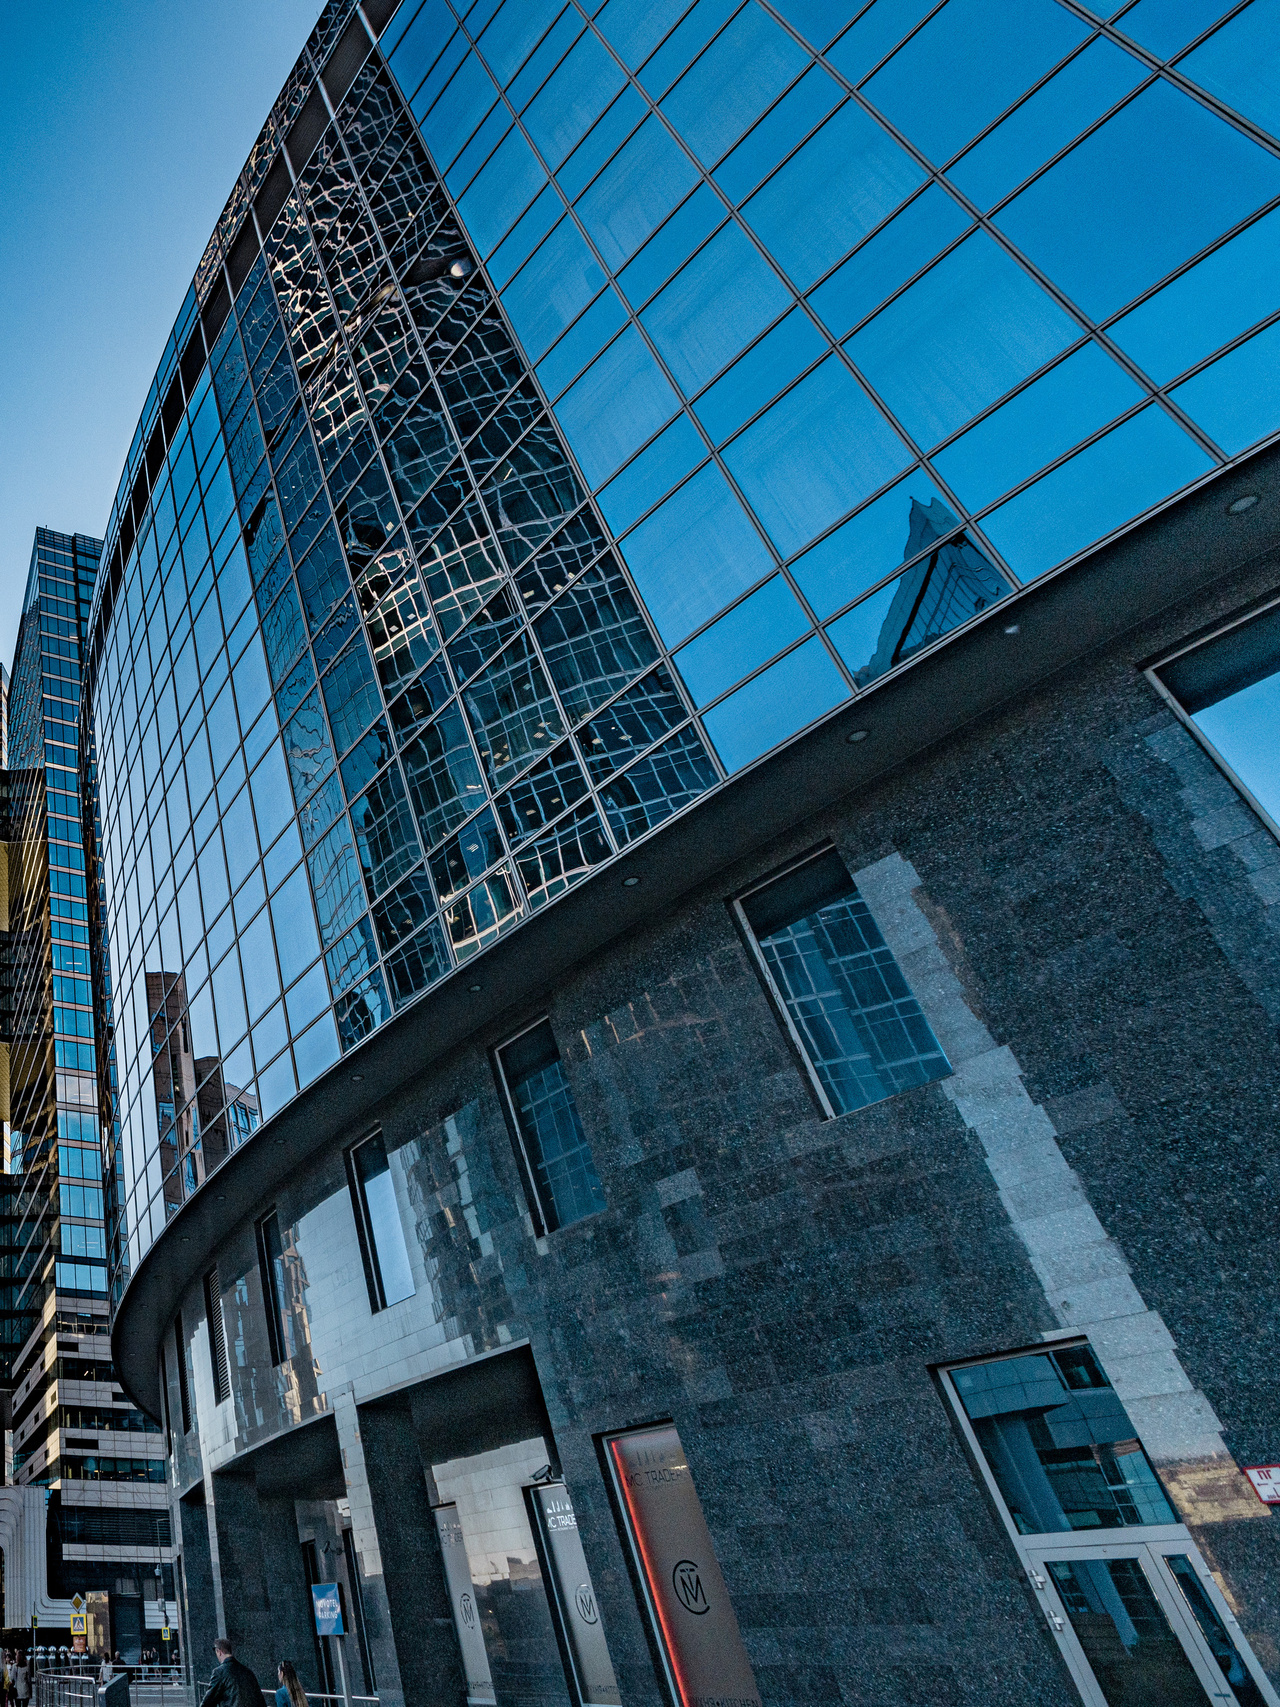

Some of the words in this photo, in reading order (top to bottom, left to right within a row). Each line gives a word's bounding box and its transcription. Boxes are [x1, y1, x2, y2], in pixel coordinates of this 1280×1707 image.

[1257, 1469, 1272, 1480] ПГ
[315, 1599, 338, 1608] NOVOTEL
[318, 1611, 338, 1619] PARKING
